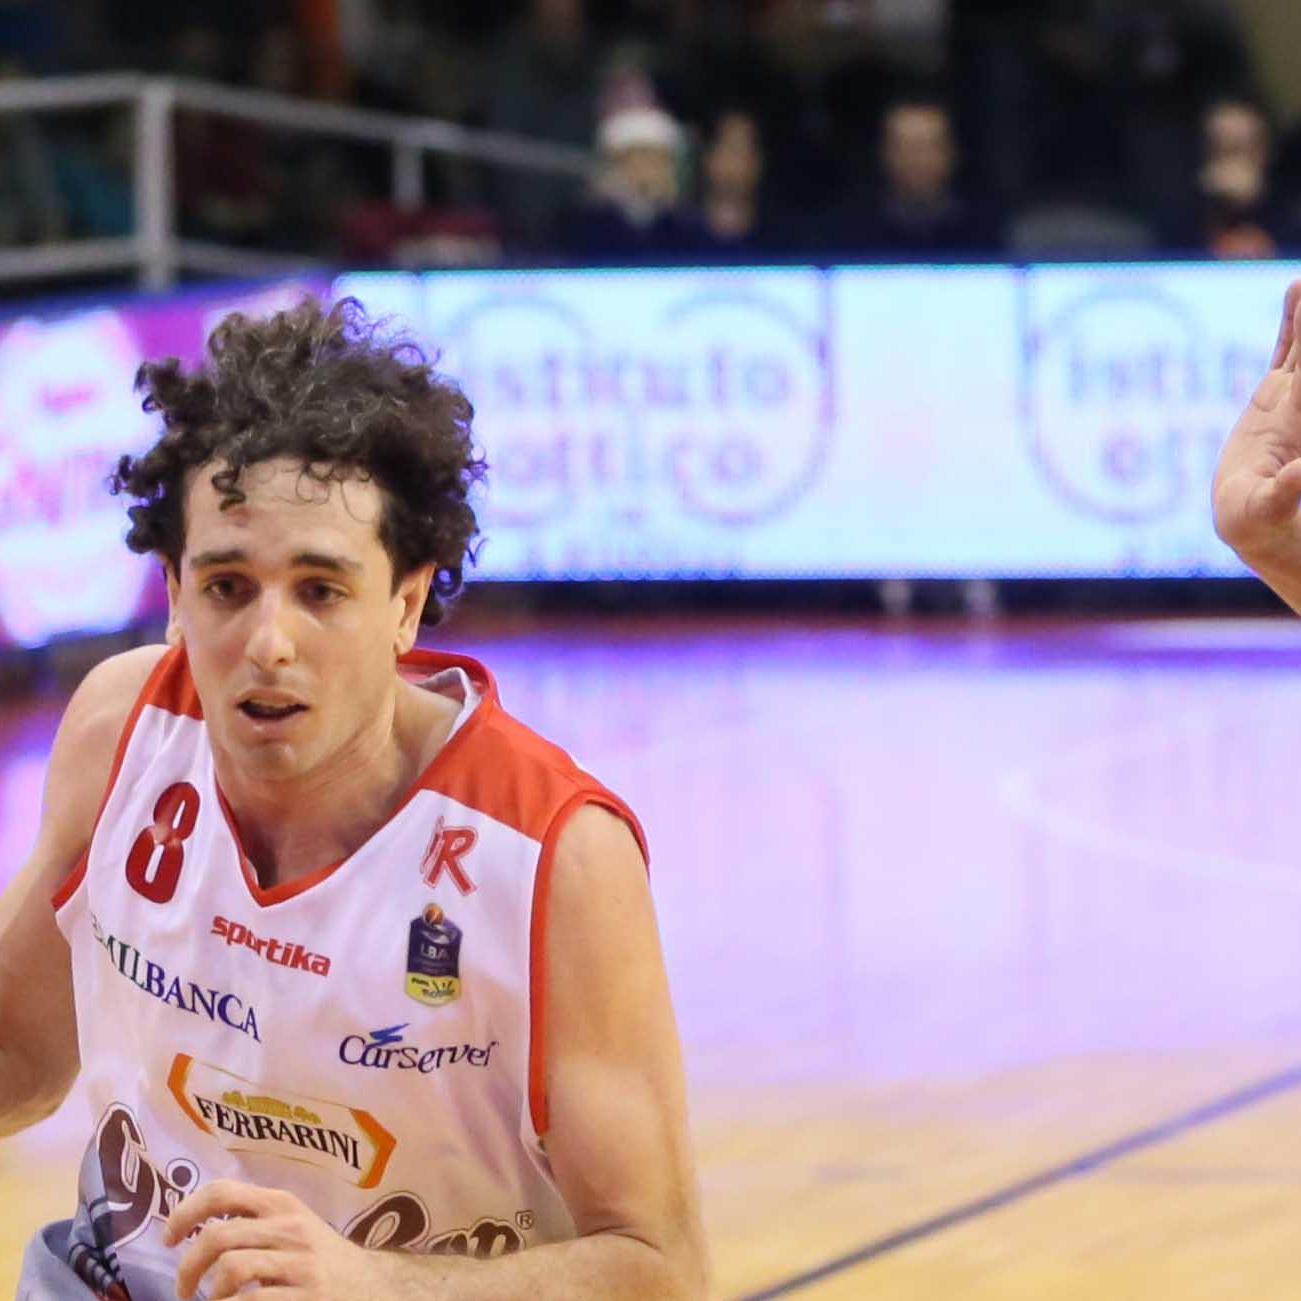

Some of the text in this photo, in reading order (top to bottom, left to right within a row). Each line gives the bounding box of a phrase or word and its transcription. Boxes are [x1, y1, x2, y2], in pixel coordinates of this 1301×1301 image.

[125, 782, 201, 903] 8
[210, 915, 332, 977] sportika
[193, 1094, 361, 1170] FERRARINI
